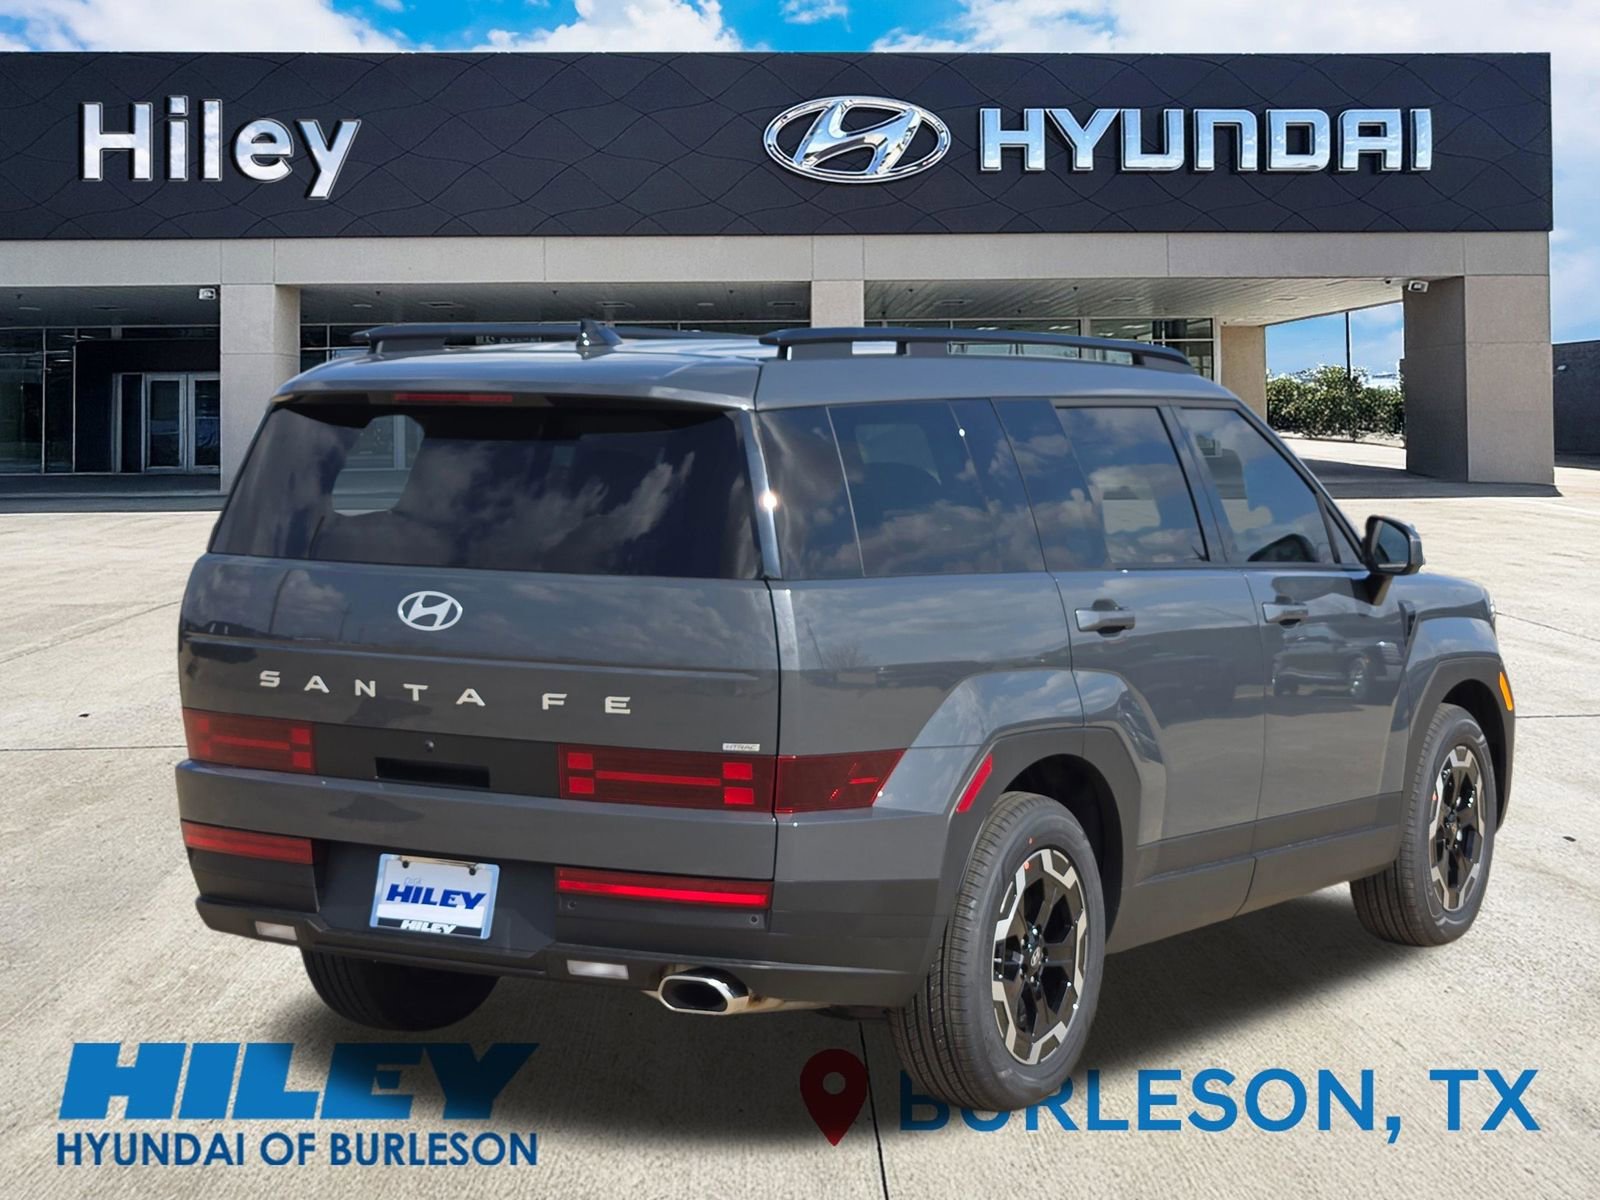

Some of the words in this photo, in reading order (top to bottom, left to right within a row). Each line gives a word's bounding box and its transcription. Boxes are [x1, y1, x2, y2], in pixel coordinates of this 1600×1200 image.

[80, 95, 362, 200] Hiley
[979, 107, 1434, 172] HYUNDAI
[258, 670, 486, 707] SANTA
[541, 692, 631, 715] FE
[386, 884, 487, 910] HILEY
[400, 919, 457, 935] HILEY
